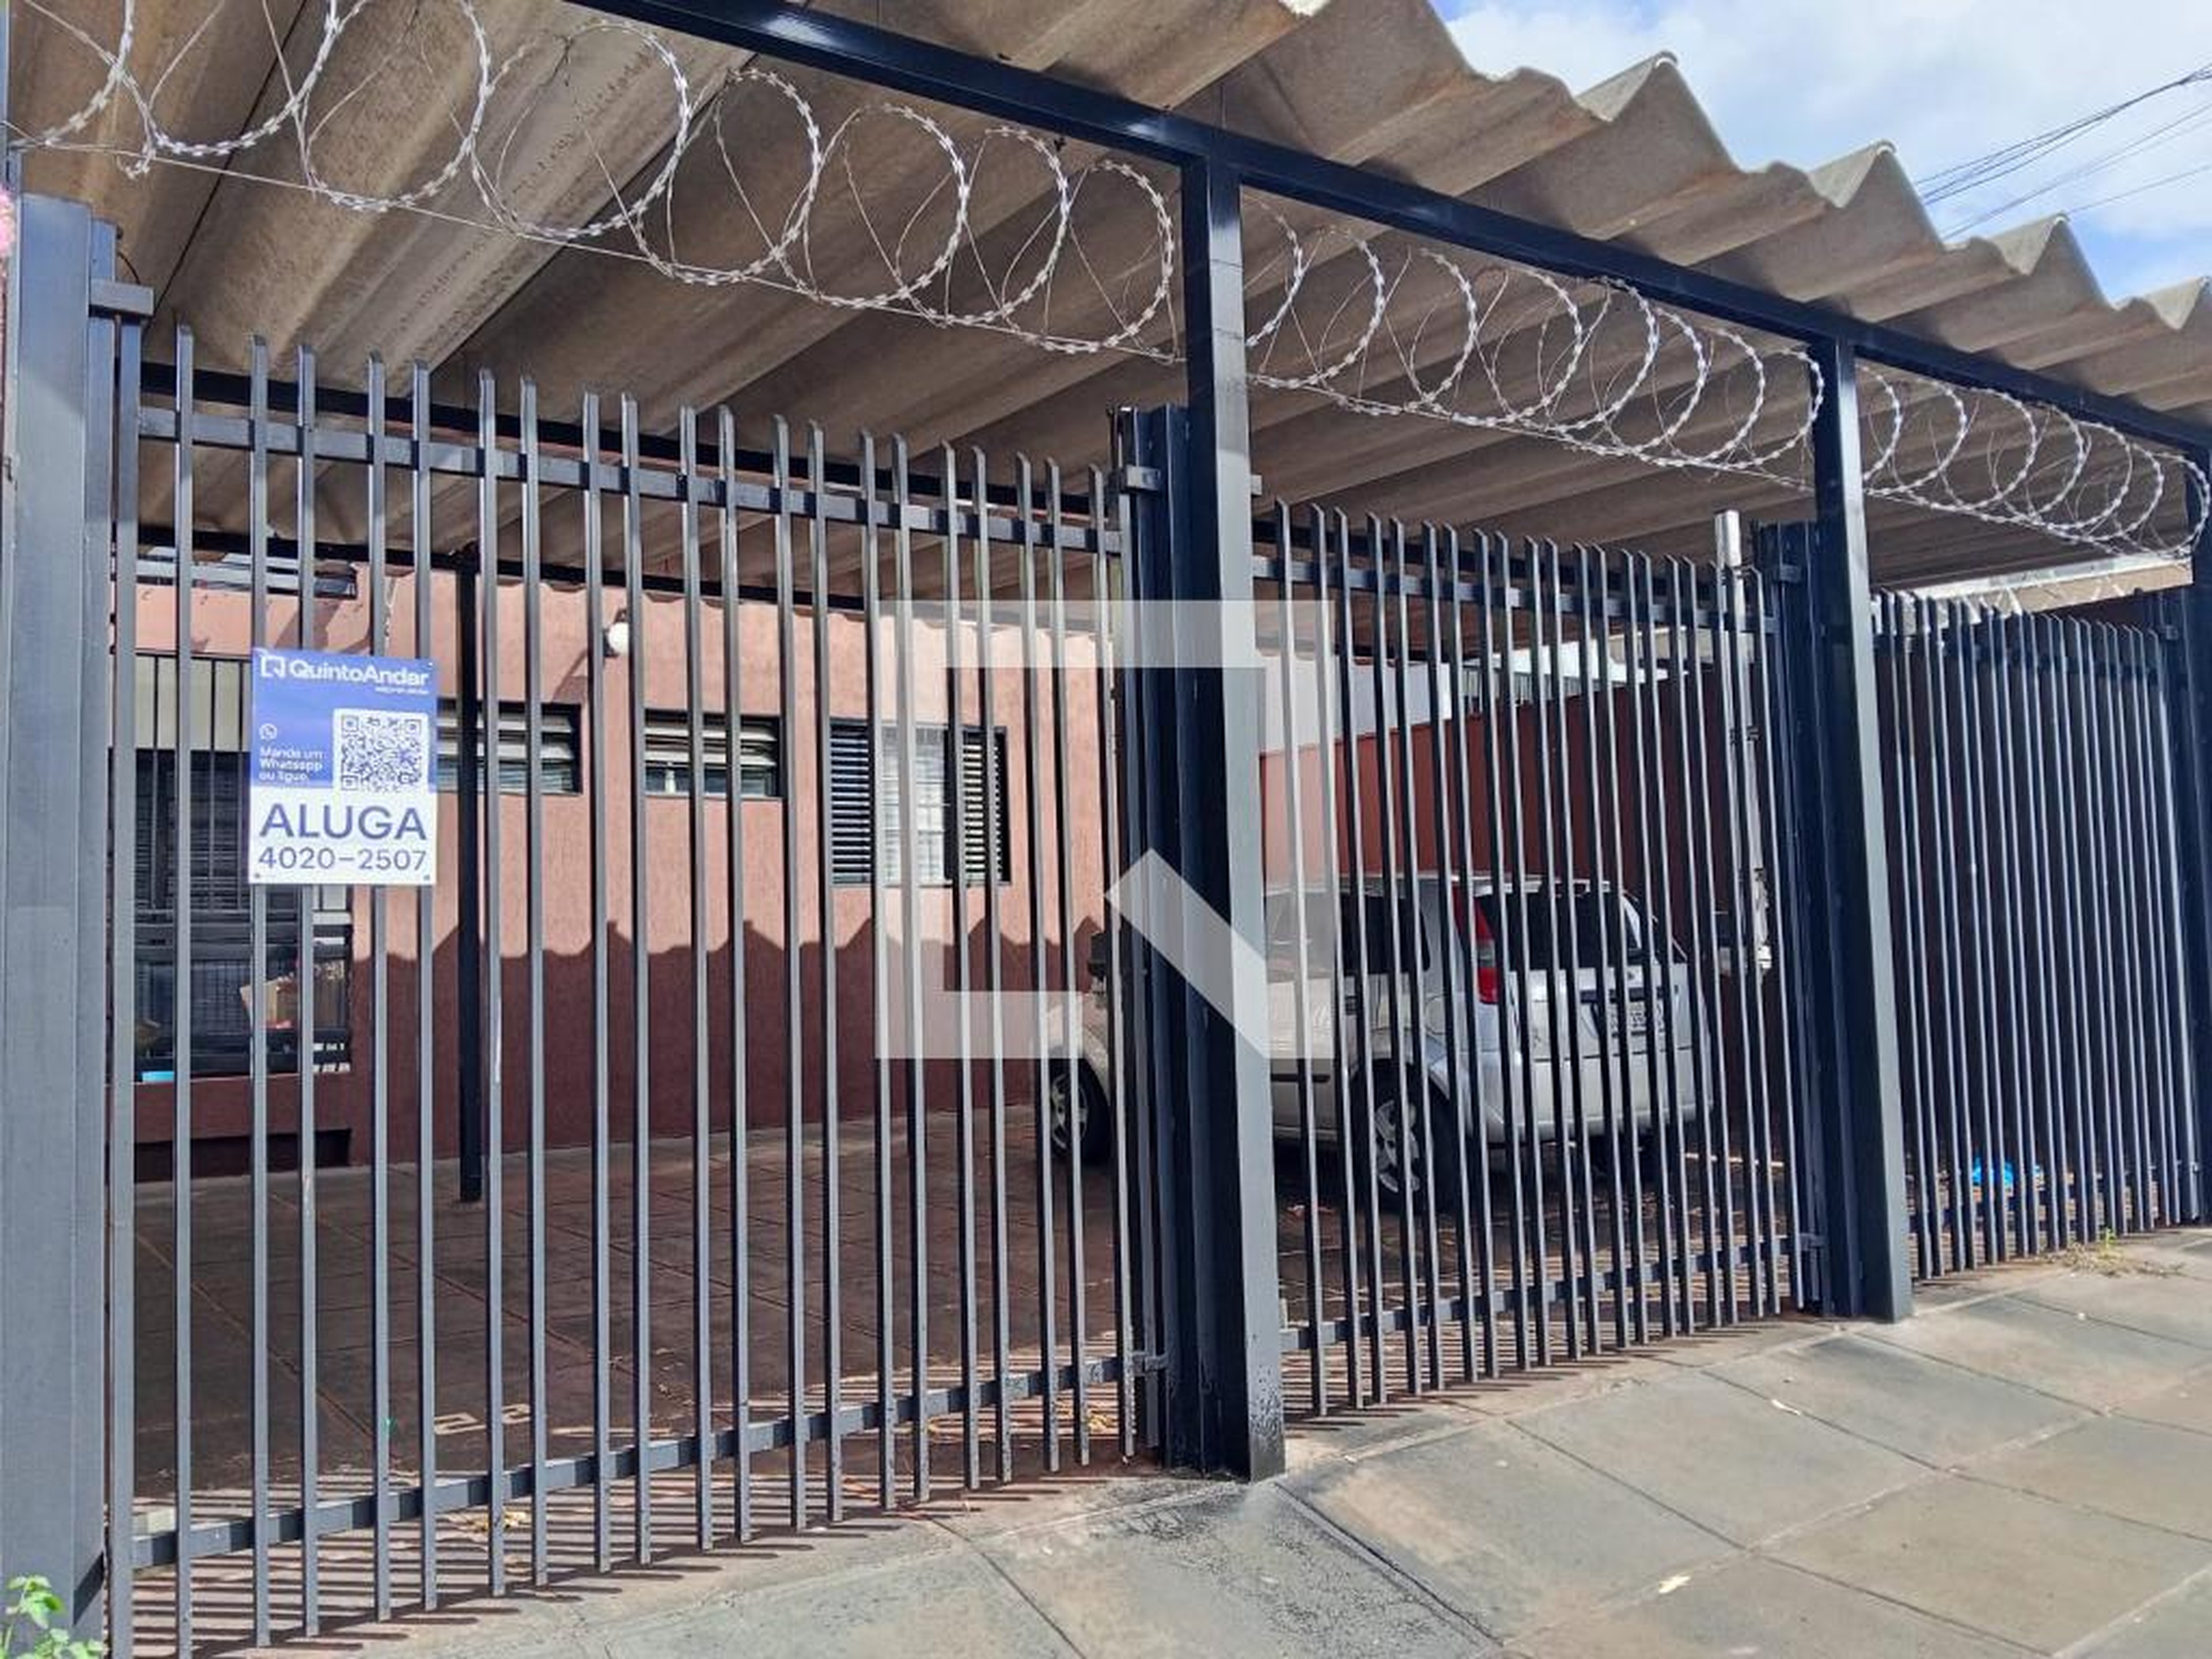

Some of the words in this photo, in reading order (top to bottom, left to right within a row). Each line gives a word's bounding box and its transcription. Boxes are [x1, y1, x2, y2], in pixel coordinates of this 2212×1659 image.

[290, 660, 429, 686] QuintoAndar
[304, 750, 323, 759] um
[259, 772, 275, 781] ou
[259, 804, 427, 840] ALUGA
[258, 847, 426, 870] 4020-2507
